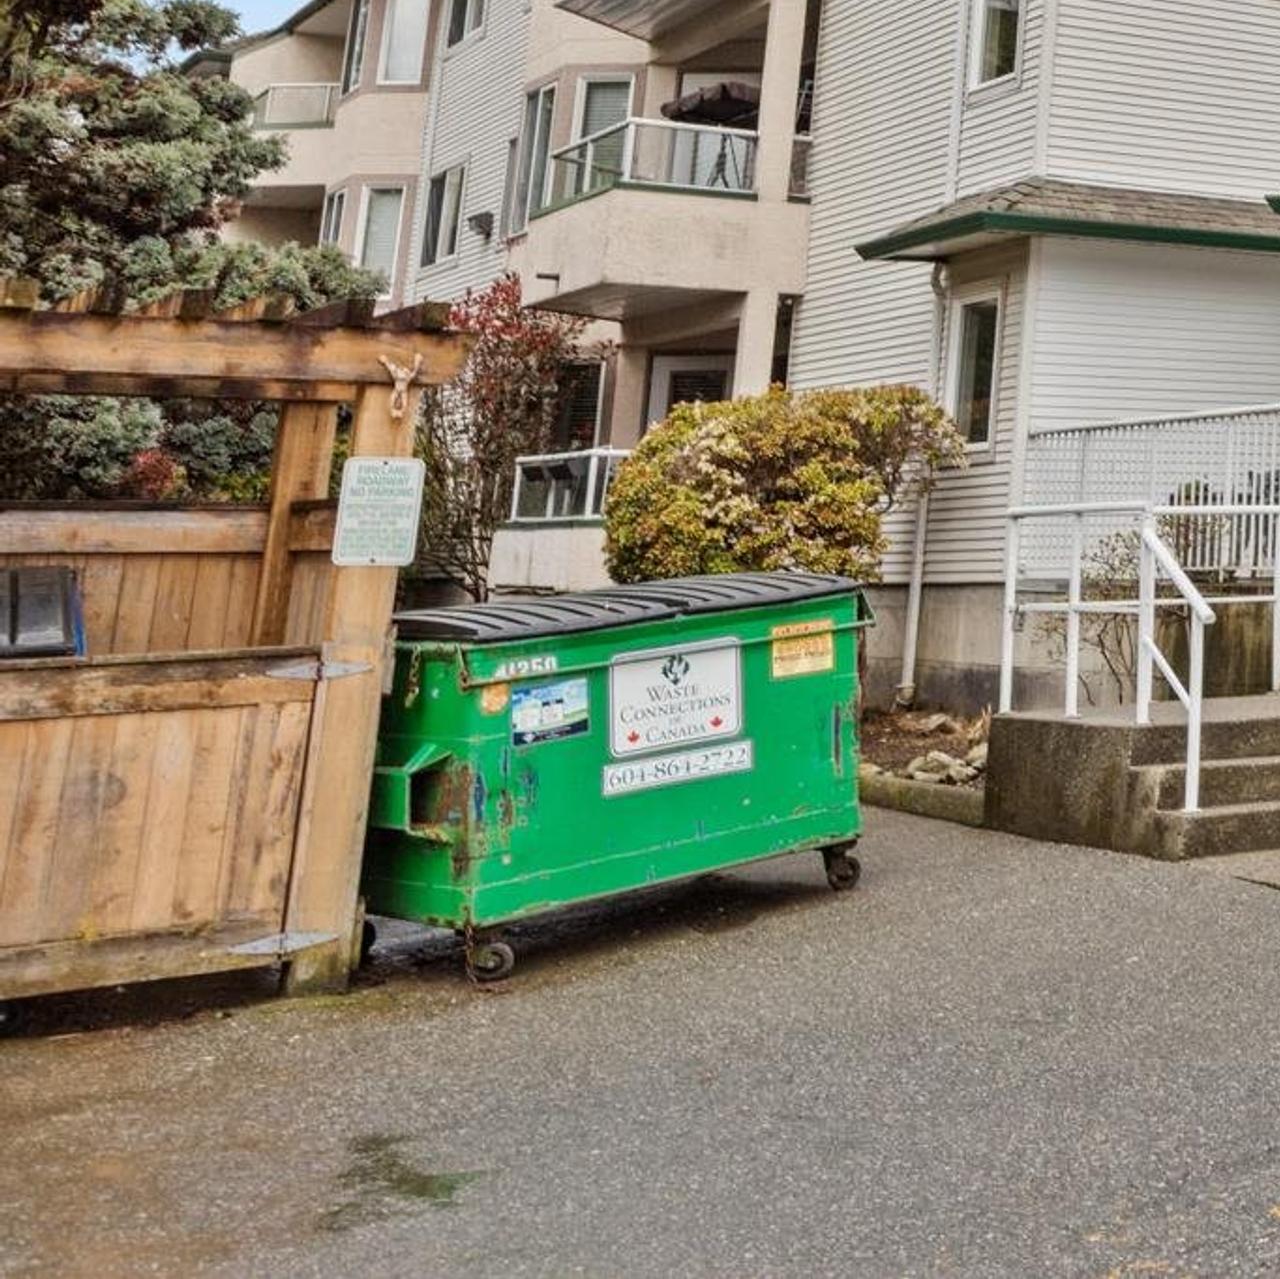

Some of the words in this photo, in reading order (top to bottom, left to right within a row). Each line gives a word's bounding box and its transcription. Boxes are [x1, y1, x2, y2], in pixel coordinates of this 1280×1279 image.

[646, 683, 698, 702] WASTE
[620, 695, 731, 723] CONNECTIONS
[645, 723, 706, 743] CANADA
[609, 746, 746, 789] 604-864-2722
